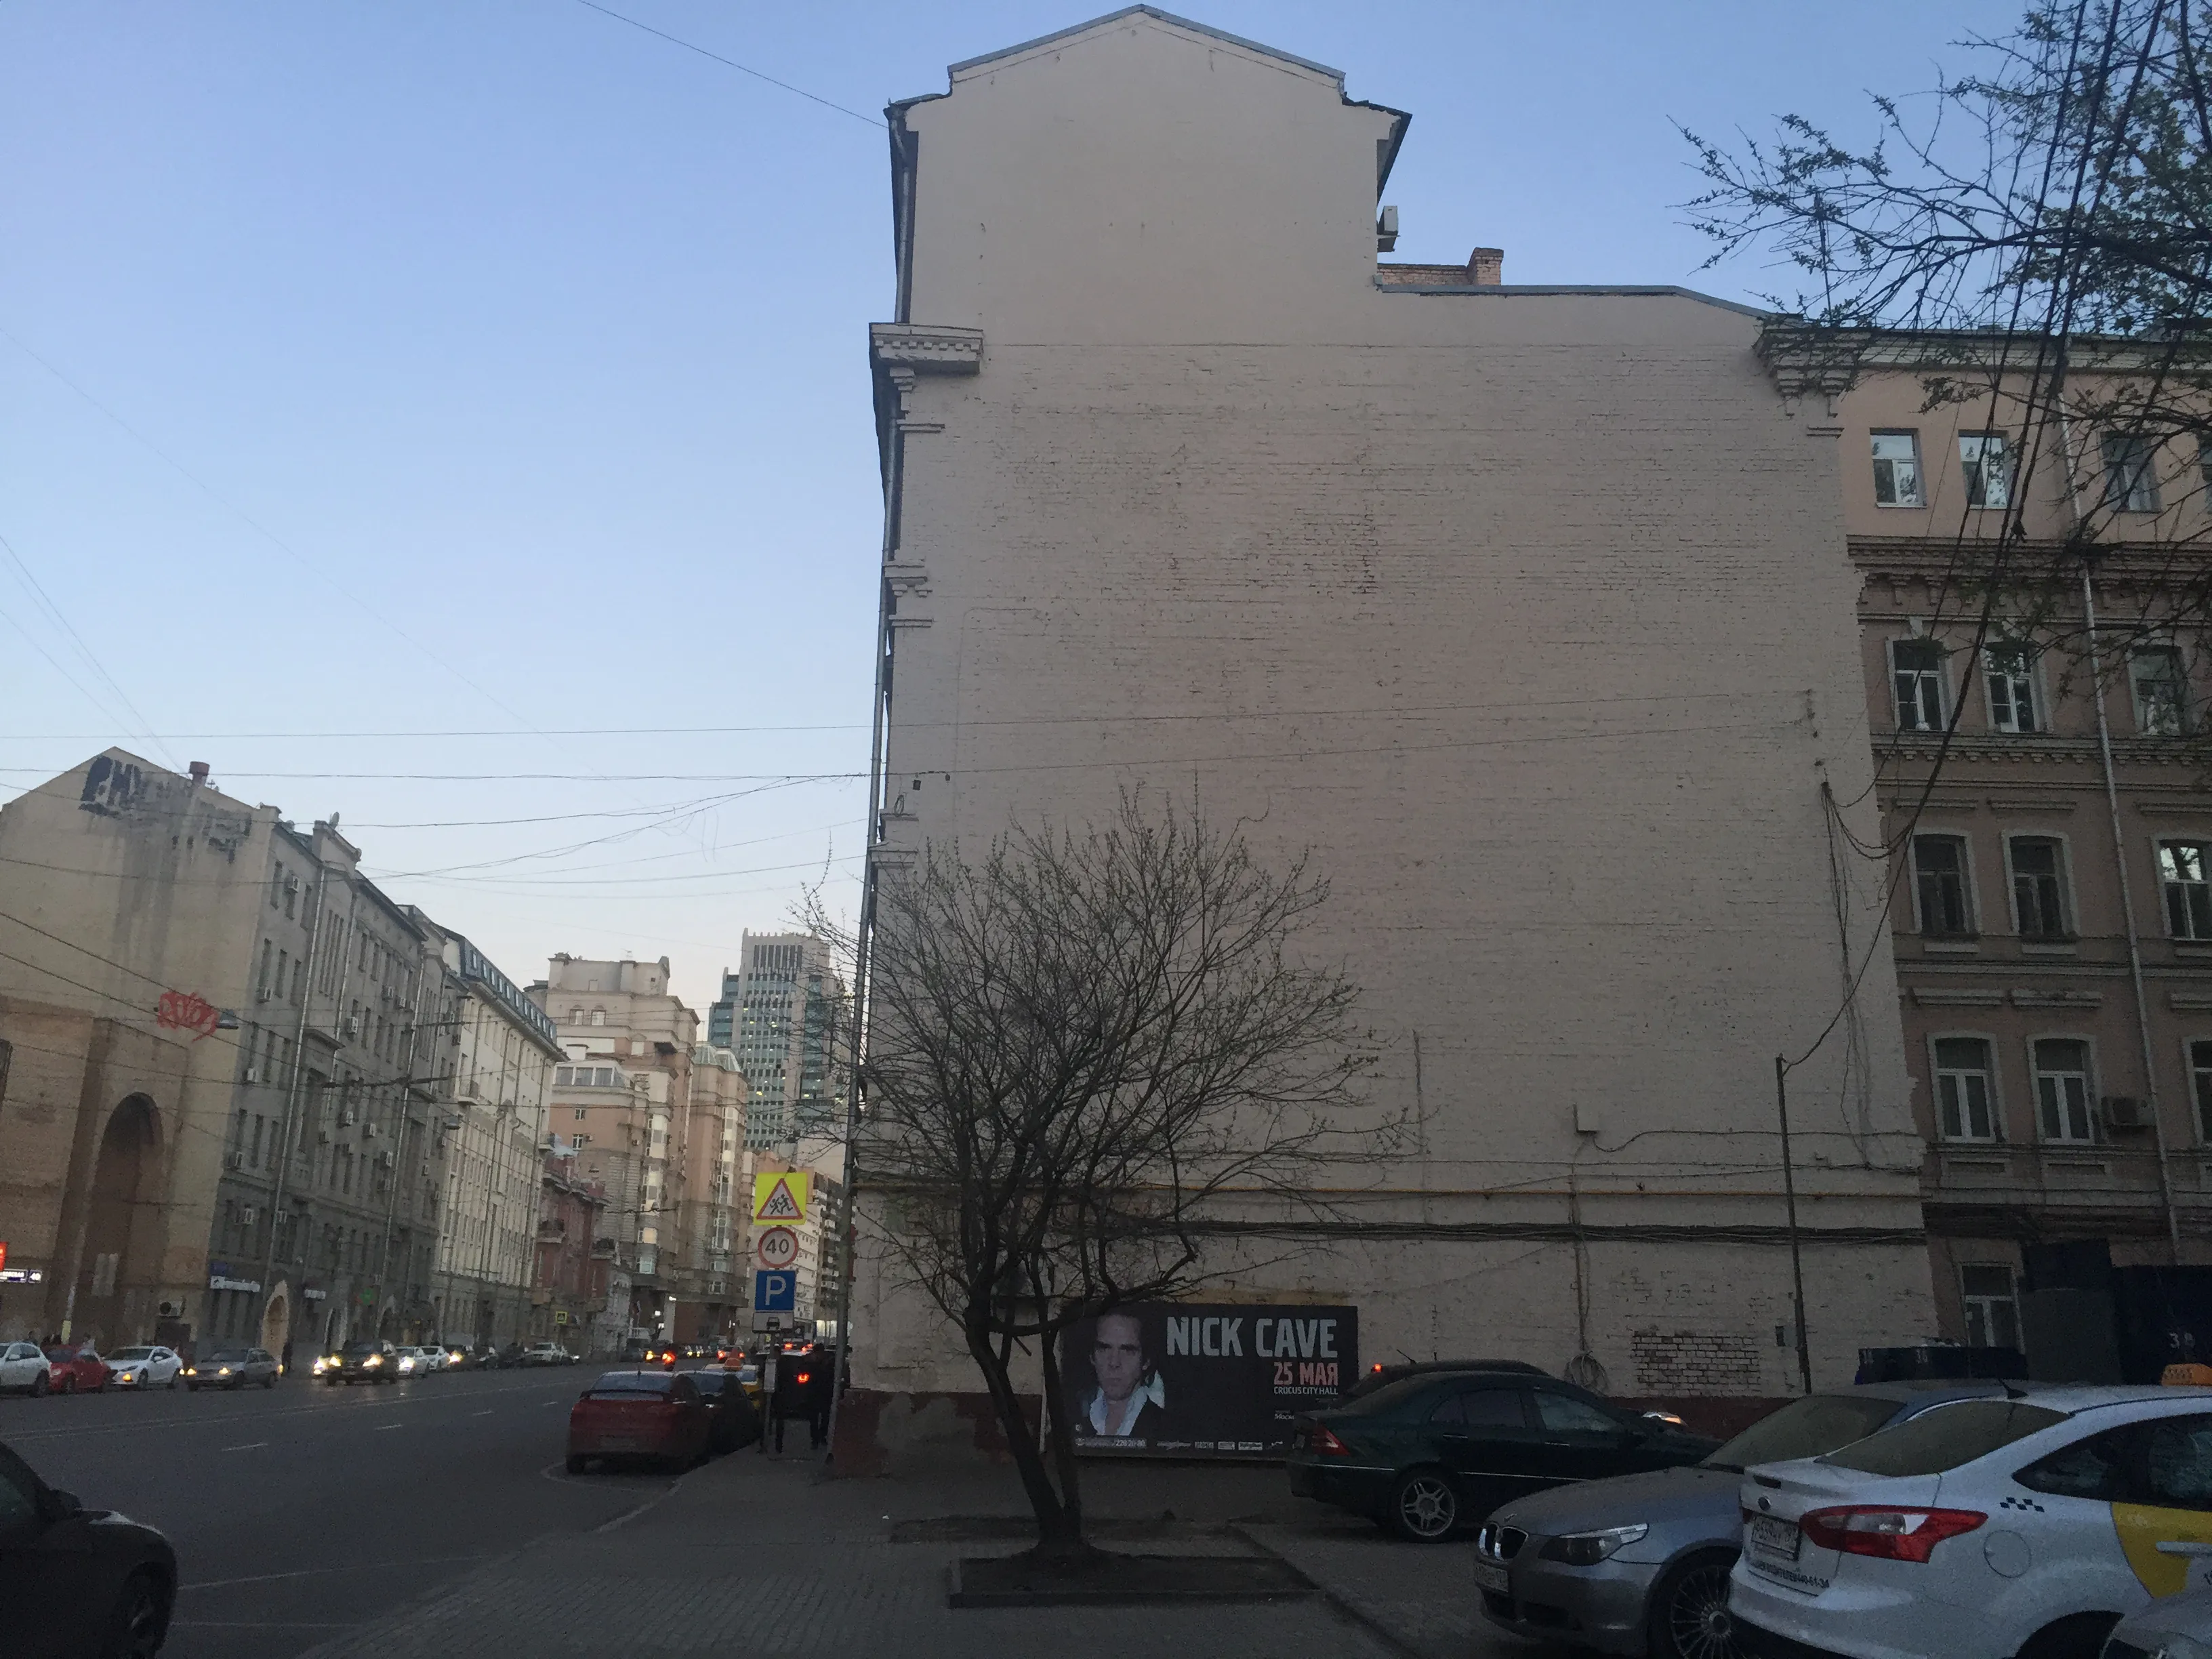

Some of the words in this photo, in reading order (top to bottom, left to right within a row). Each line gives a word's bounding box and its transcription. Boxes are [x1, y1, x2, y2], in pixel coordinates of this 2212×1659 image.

[765, 1238, 789, 1254] 40
[765, 1275, 787, 1306] P
[1166, 1316, 1244, 1357] NICK
[1255, 1317, 1338, 1358] CAVE
[1273, 1361, 1293, 1385] 25
[1299, 1361, 1338, 1387] МАЯ
[1273, 1386, 1302, 1395] CROCUS
[1302, 1386, 1318, 1395] CITY
[1319, 1387, 1338, 1395] HALL
